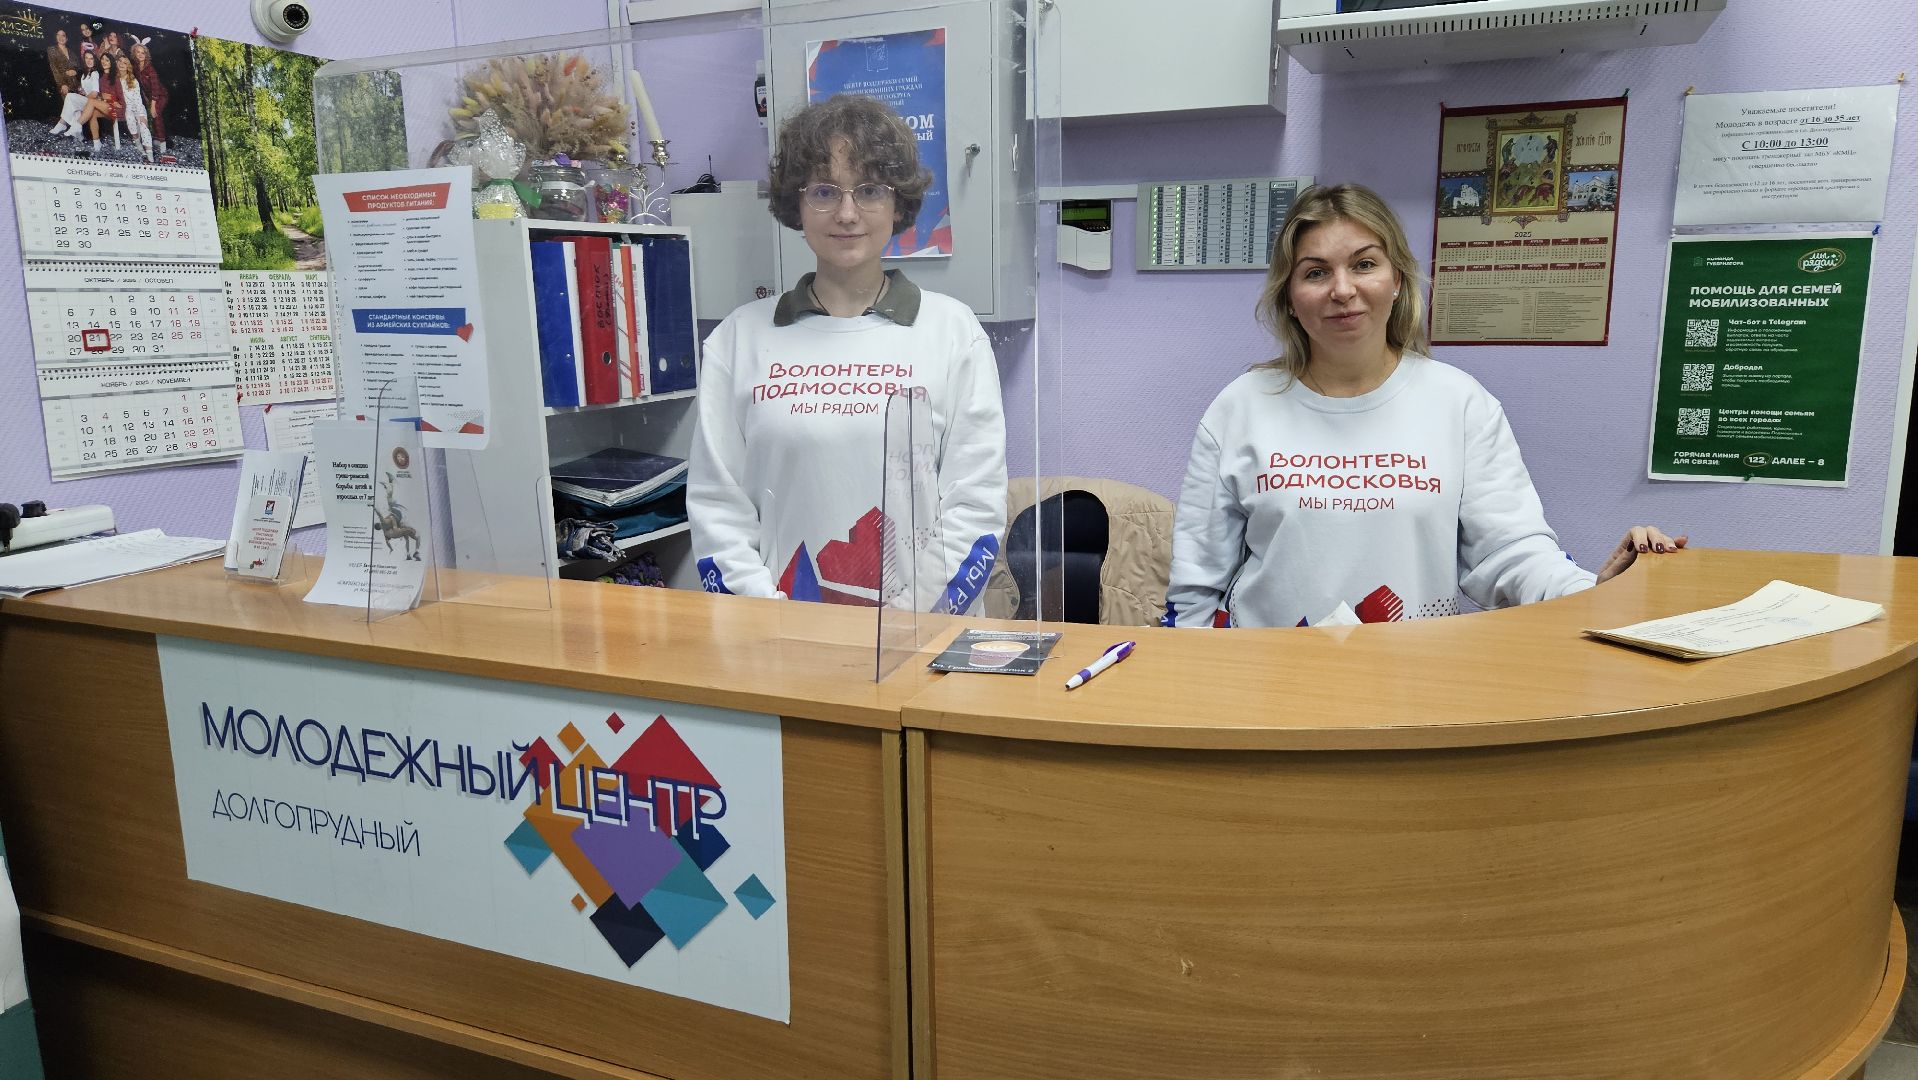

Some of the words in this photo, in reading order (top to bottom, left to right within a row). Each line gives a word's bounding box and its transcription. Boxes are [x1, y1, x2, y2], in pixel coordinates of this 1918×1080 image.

[1741, 107, 1786, 118] Уважаемые
[1788, 103, 1837, 114] посетители!
[1715, 121, 1756, 129] Молодежь
[1764, 118, 1798, 128] возрасте
[1800, 118, 1809, 126] от
[1834, 114, 1844, 122] 35
[1742, 140, 1750, 149] С
[1754, 139, 1782, 148] 10:00
[1784, 140, 1797, 148] до
[1800, 137, 1828, 147] 13:00
[390, 192, 436, 200] НЕОБХОДИМЫХ
[94, 202, 107, 211] 10
[116, 203, 126, 211] 11
[1690, 286, 1756, 296] ПОМОЩЬ
[1758, 286, 1788, 296] ДЛЯ
[1792, 282, 1842, 295] СЕМЕЙ
[1689, 298, 1829, 308] МОБИЛИЗОВАННЫХ
[148, 307, 160, 315] 10
[168, 307, 178, 315] 11
[187, 307, 199, 315] 12
[109, 321, 120, 329] 15
[150, 320, 162, 328] 17
[170, 319, 181, 327] 18
[189, 319, 200, 327] 19
[376, 320, 412, 328] АРМЕЙСКИХ
[412, 320, 450, 328] СУХПАЙКОВ:
[1768, 318, 1806, 326] Telegram
[130, 333, 143, 341] 23
[152, 332, 164, 340] 24
[190, 331, 202, 339] 26
[70, 348, 82, 356] 27
[153, 345, 163, 353] 31
[769, 363, 913, 379] ВОЛОНТЕРЫ
[1722, 364, 1763, 372] Добродел
[753, 382, 927, 404] ПОДМОСКОВЬЯ
[791, 403, 818, 415] МЫ
[822, 403, 879, 417] РЯДОМ
[1719, 408, 1749, 416] Центры
[1750, 410, 1782, 418] помощи
[332, 461, 347, 469] Набор
[1270, 452, 1427, 470] ВОЛОНТЕРЫ
[1748, 456, 1767, 465] 122,
[1772, 458, 1806, 466] ДАЛЕЕ
[1818, 458, 1825, 466] 8
[336, 482, 354, 490] борьбы
[1257, 474, 1441, 494] ПОДМОСКОВЬЯ
[1298, 497, 1327, 509] МЫ
[1332, 498, 1394, 512] РЯДОМ
[966, 547, 994, 589] МЫ
[202, 701, 541, 805] МОЛОДЕЖНЫЙ
[551, 760, 728, 838] ЦЕНТР
[212, 789, 421, 857] ДОЛГОПРУДНЫЙ
